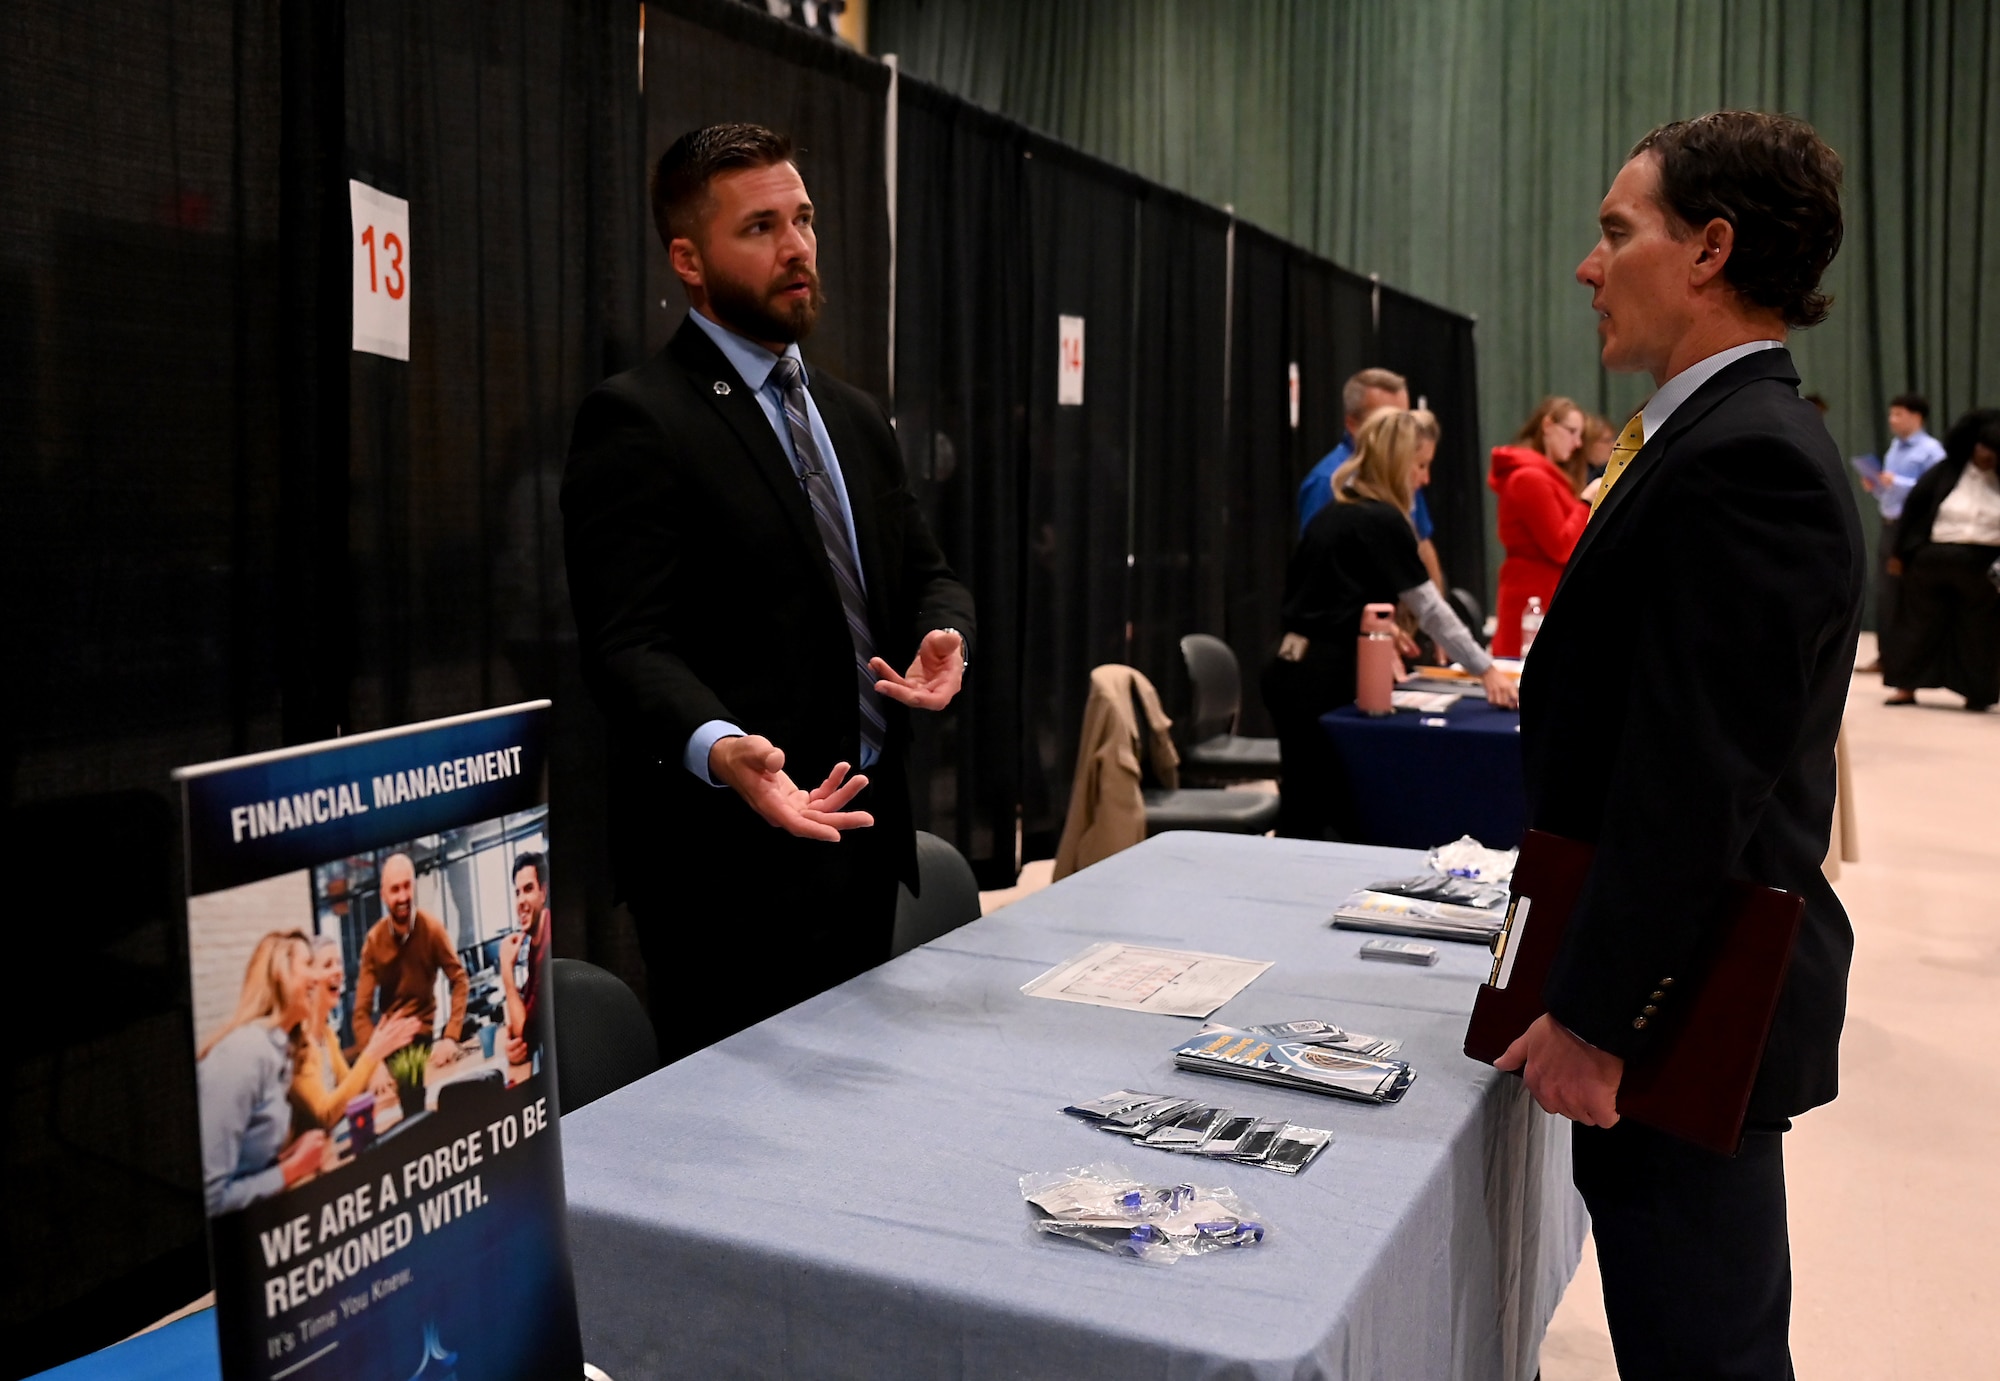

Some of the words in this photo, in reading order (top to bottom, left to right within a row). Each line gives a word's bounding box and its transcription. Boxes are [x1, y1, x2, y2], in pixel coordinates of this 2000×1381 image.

[361, 225, 405, 300] 13
[1062, 337, 1082, 373] 14
[230, 782, 369, 843] FINANCIAL
[372, 746, 522, 809] MANAGEMENT
[260, 1214, 312, 1268] WE
[319, 1183, 373, 1244] ARE
[379, 1173, 398, 1213] A
[402, 1131, 483, 1199] FORCE
[487, 1115, 518, 1155] TO
[523, 1097, 547, 1140] BE
[265, 1212, 413, 1319] RECKONED
[418, 1175, 489, 1235] WITH.
[267, 1332, 297, 1360] It's
[298, 1309, 338, 1343] Time
[339, 1291, 370, 1319] You
[371, 1268, 414, 1302] Know.
